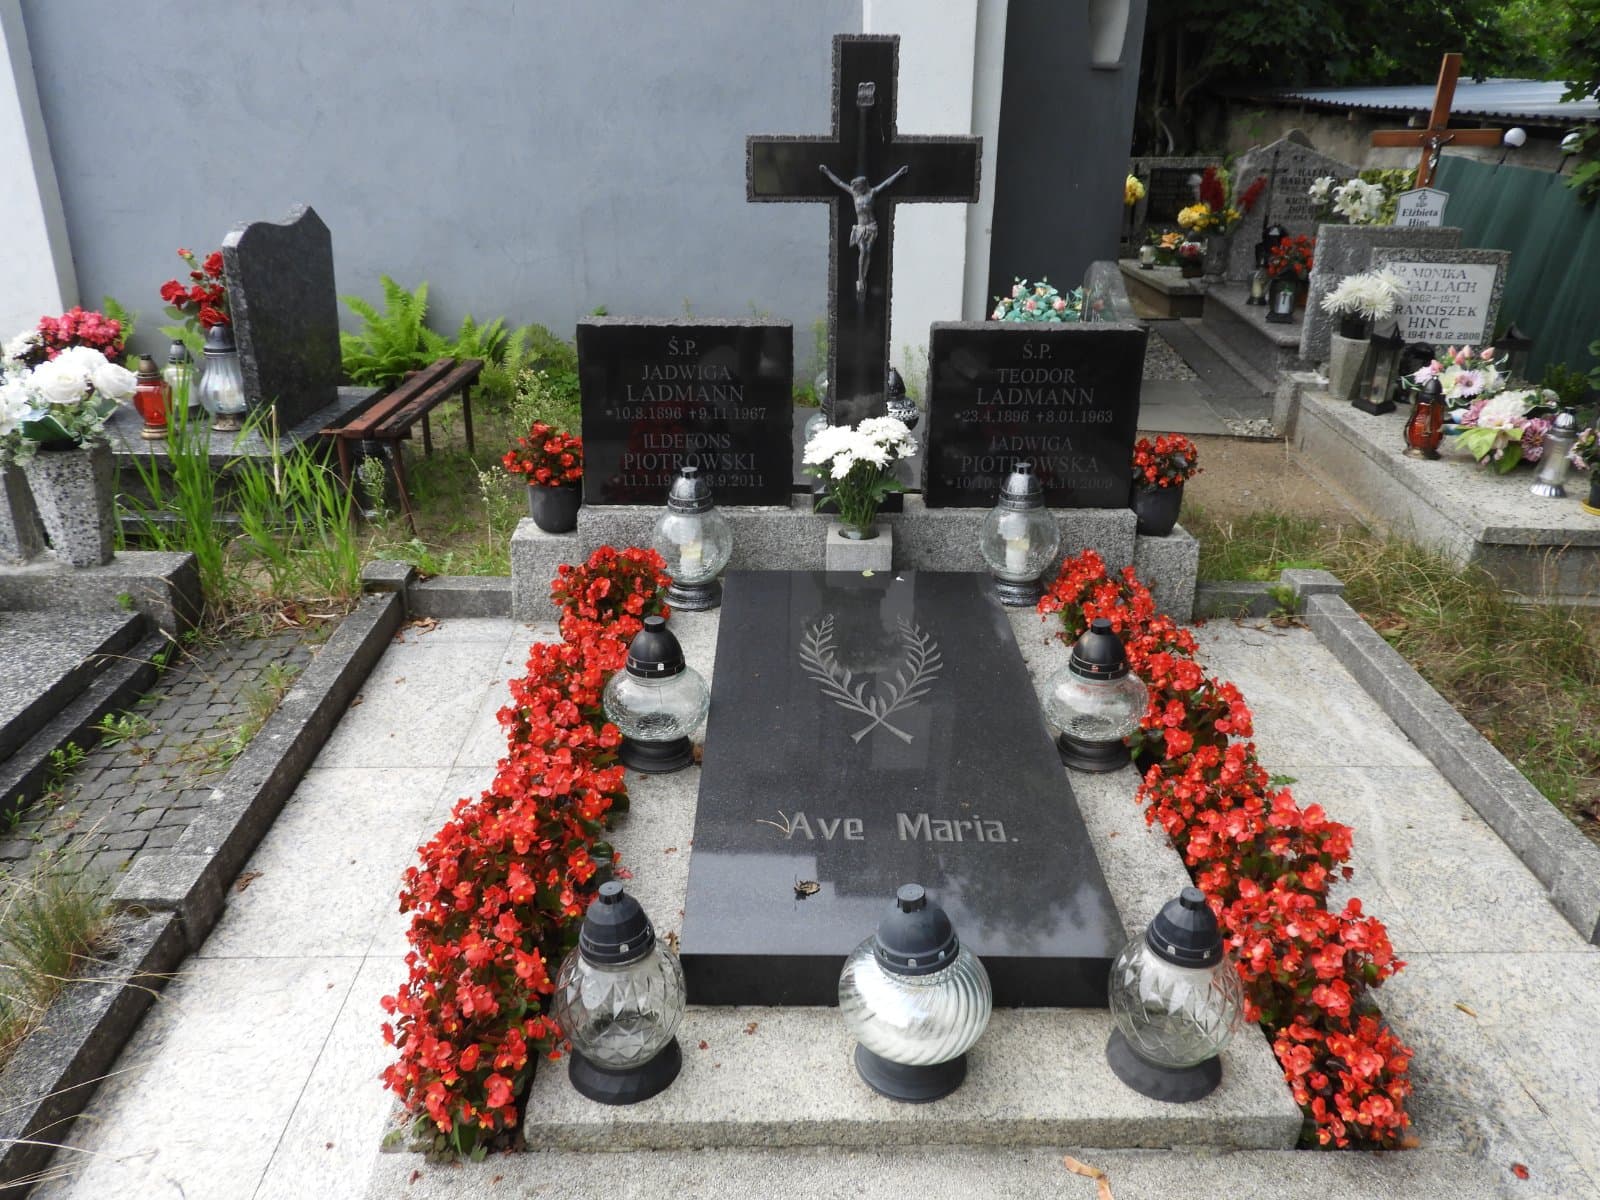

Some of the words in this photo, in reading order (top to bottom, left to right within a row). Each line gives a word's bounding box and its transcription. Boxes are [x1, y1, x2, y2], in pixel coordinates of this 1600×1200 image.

[1413, 267, 1467, 279] MONIKA
[1407, 280, 1478, 293] ALLACH
[1408, 316, 1450, 329] HINC
[641, 364, 732, 380] JADWIGA
[996, 368, 1076, 384] TEODOR
[626, 384, 745, 401] LADMANN
[976, 387, 1095, 405] LADMANN
[643, 433, 731, 449] ILDEFONS
[990, 436, 1073, 451] JADWIGA
[624, 453, 756, 470] PIOTROWSKI
[960, 456, 1099, 473] PIOTROWSKA
[785, 811, 864, 841] Ave
[896, 811, 1019, 843] Maria.
